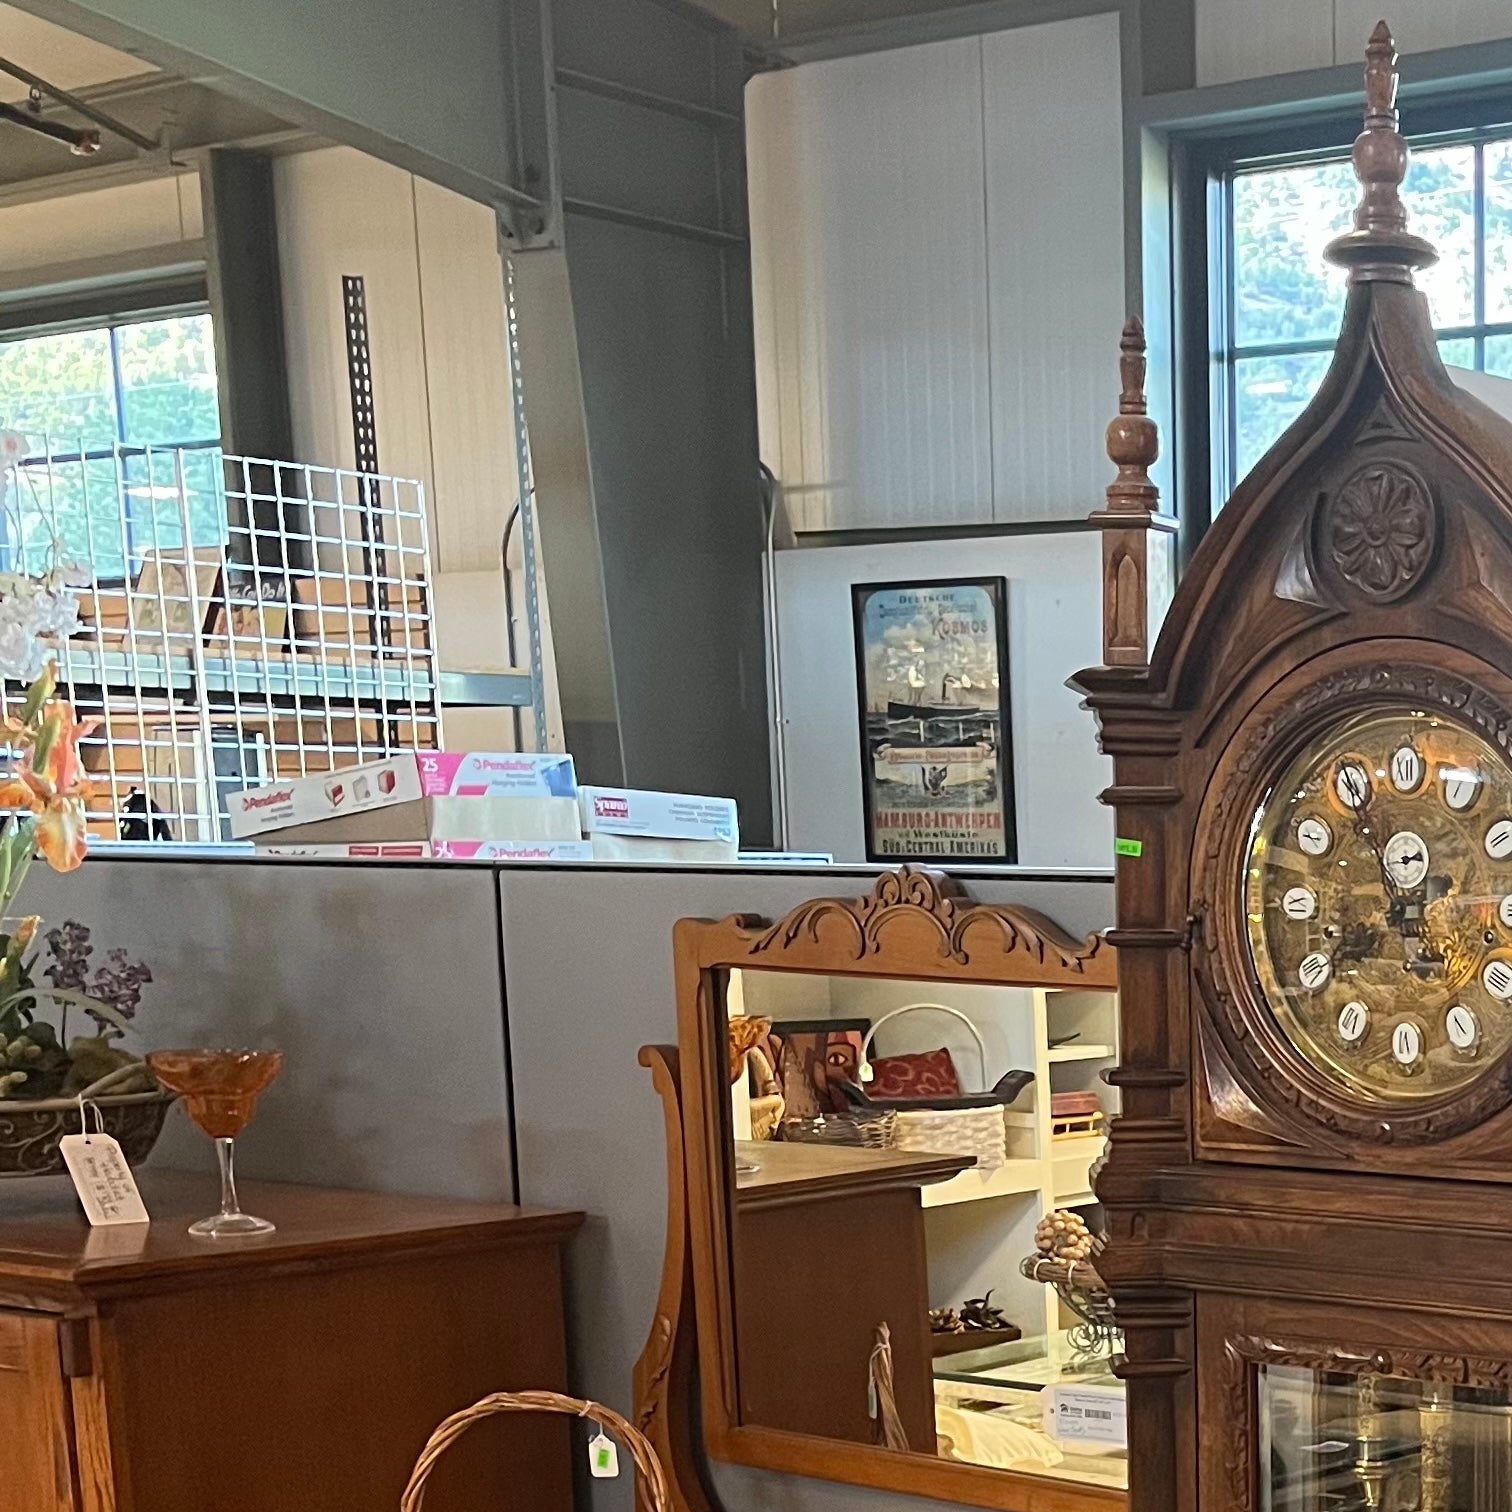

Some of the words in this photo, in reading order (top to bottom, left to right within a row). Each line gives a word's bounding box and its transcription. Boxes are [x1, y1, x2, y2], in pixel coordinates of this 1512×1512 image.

[932, 618, 988, 639] KOSMOS
[421, 757, 439, 773] 25
[483, 759, 536, 771] Pendaflex
[249, 788, 295, 809] Pendaflex
